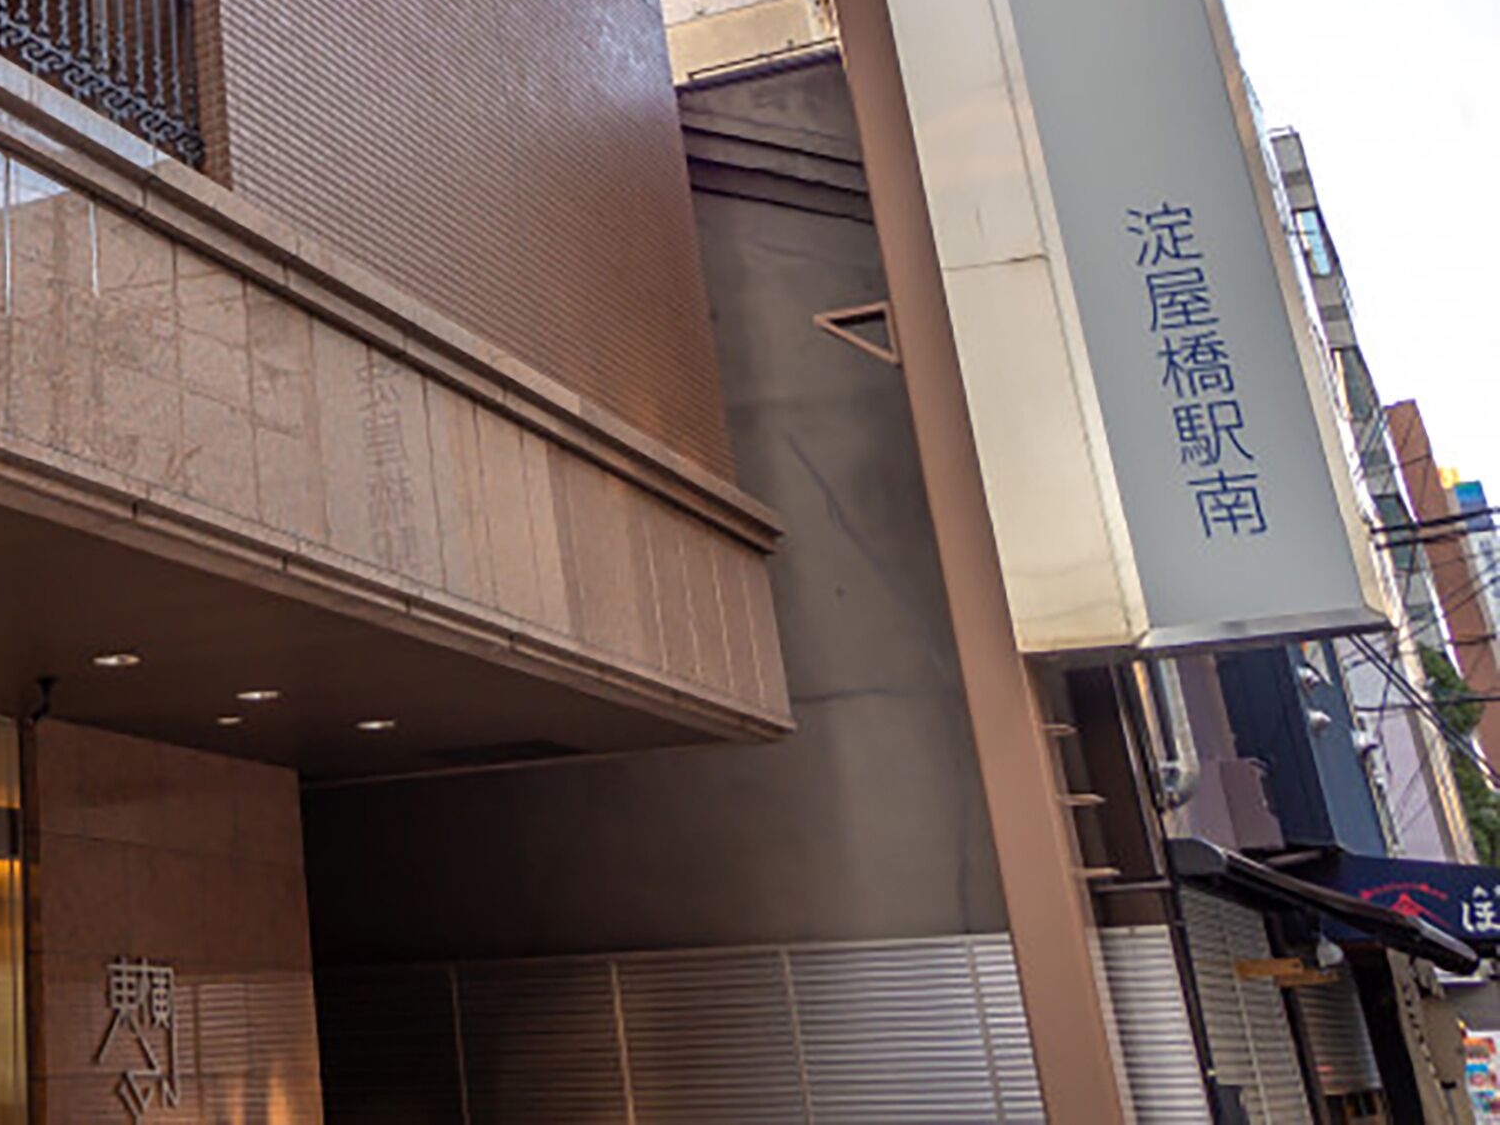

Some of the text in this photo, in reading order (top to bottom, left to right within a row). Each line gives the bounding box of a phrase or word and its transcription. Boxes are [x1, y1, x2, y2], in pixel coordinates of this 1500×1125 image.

[1126, 202, 1268, 539] 淀屋橋駅南
